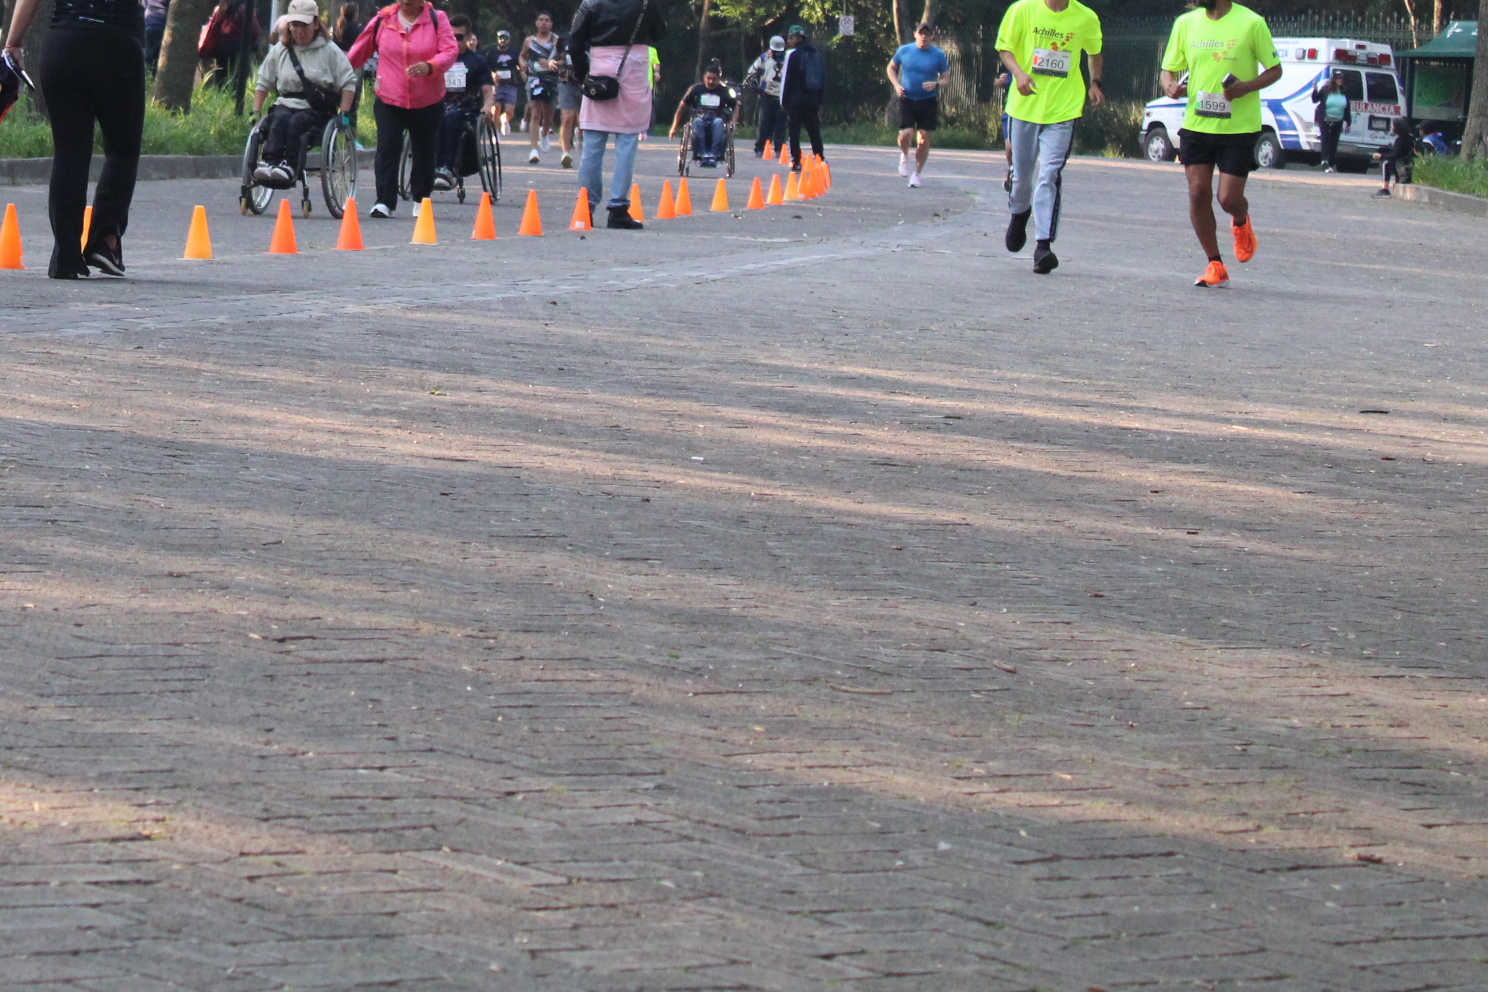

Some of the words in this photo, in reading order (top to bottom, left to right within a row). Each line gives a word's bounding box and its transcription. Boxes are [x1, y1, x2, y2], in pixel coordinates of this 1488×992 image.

[1033, 27, 1064, 38] Achilles
[1191, 39, 1225, 49] Achilles
[1038, 58, 1065, 69] 2160
[1199, 99, 1226, 111] 1599
